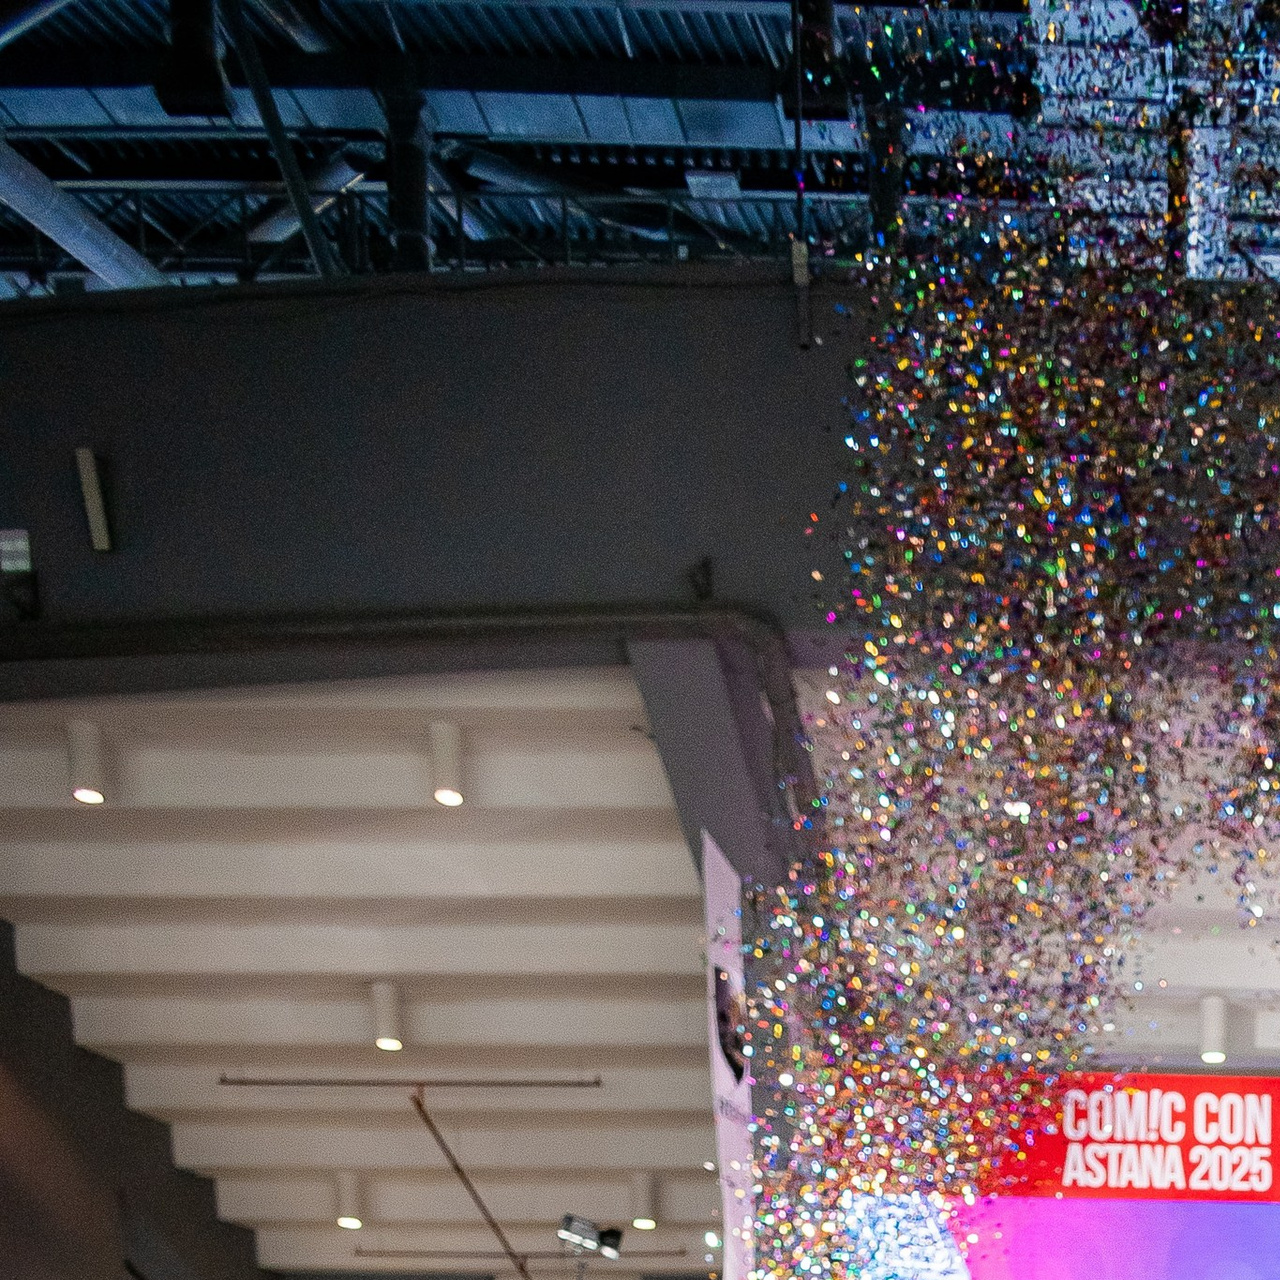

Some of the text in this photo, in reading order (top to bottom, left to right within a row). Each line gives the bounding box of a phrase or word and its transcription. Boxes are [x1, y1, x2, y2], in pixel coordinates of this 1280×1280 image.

[1193, 1092, 1272, 1145] CON
[1062, 1142, 1273, 1192] ASTANA 2025
